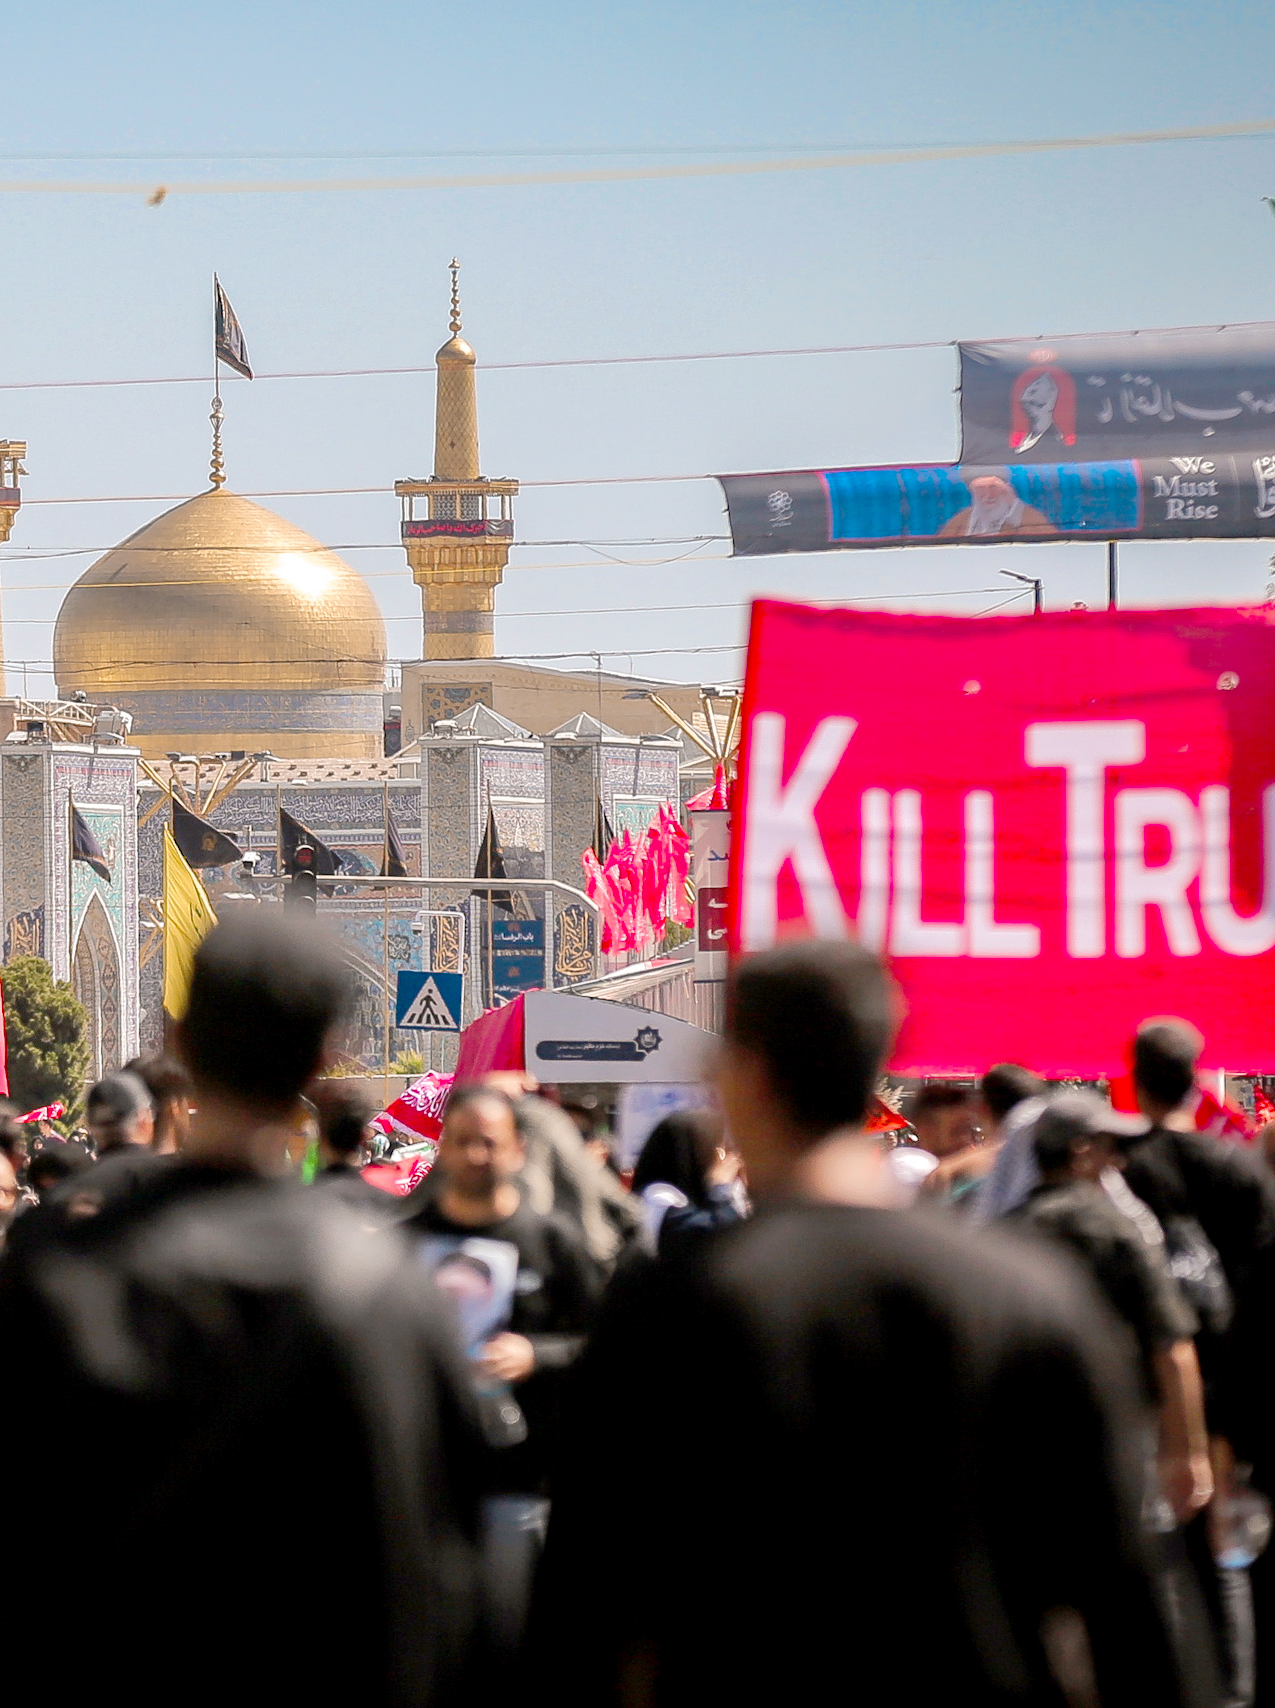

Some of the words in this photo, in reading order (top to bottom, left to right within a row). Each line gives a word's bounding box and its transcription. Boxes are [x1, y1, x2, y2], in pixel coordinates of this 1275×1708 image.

[1168, 456, 1216, 475] We
[1152, 475, 1219, 498] Must
[1165, 499, 1219, 520] Rise
[740, 711, 1040, 958] KILL
[1025, 719, 1275, 958] TRU
